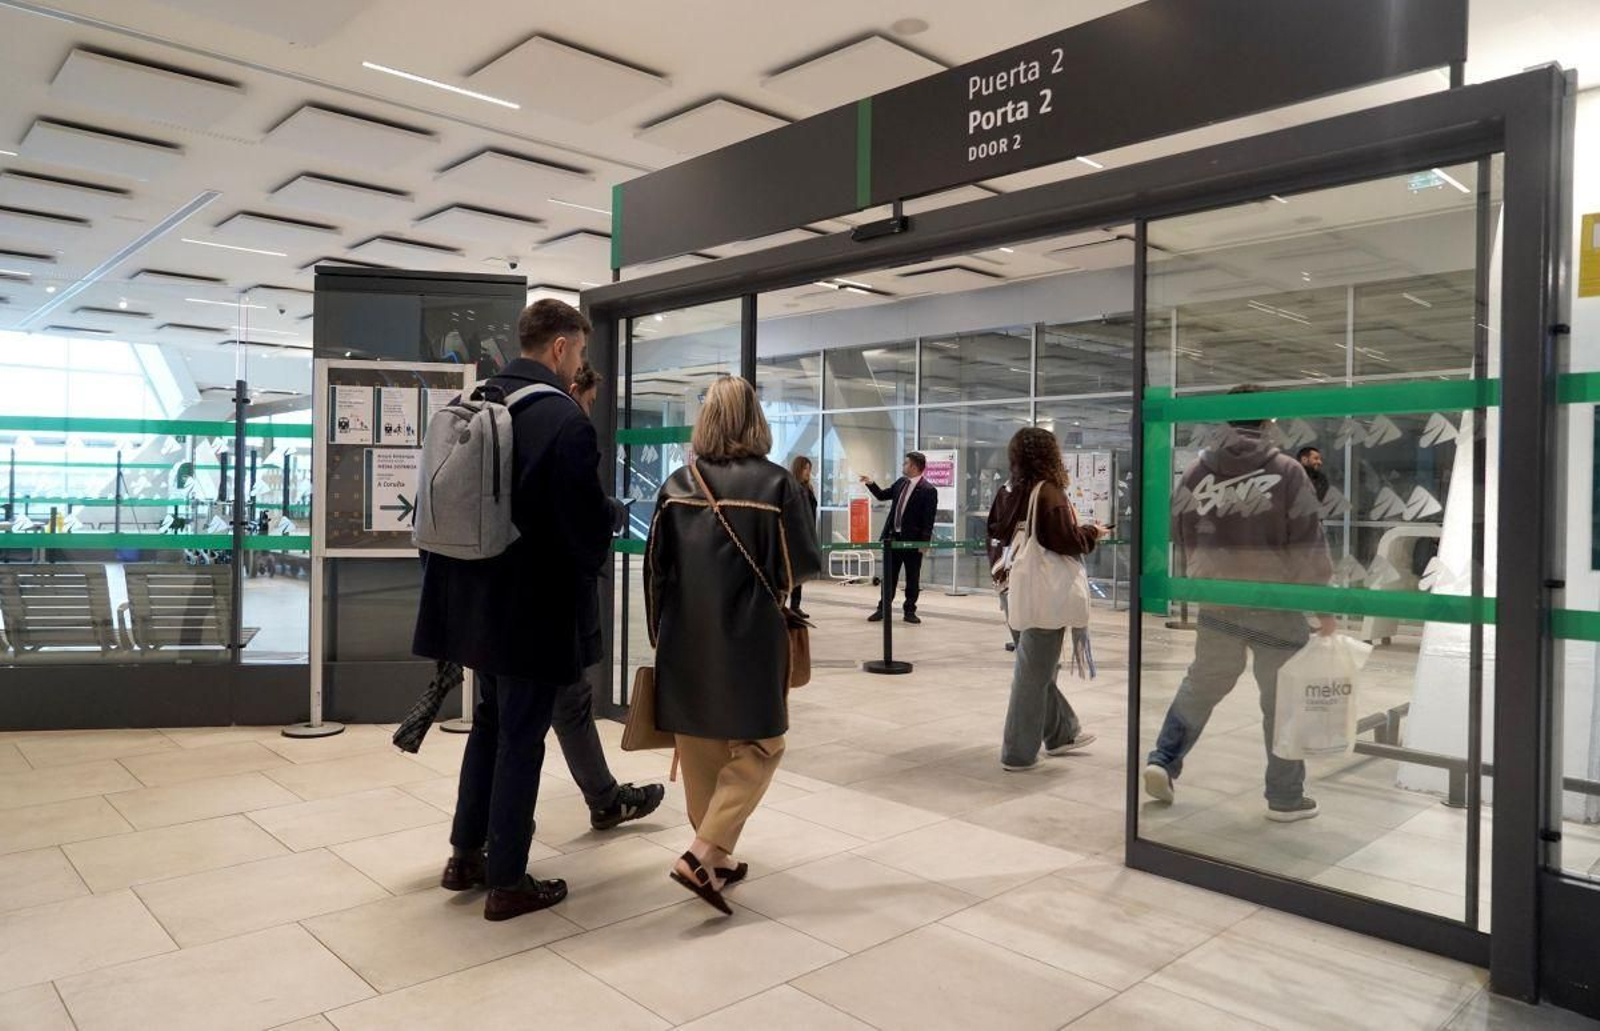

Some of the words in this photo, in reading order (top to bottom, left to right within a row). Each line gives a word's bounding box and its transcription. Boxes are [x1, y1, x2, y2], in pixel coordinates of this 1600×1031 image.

[969, 60, 1040, 100] Puerta
[1051, 48, 1064, 74] 2
[969, 100, 1029, 134] Porta
[1039, 88, 1053, 114] 2
[968, 138, 1008, 161] DOOR
[1012, 134, 1021, 150] 2
[1305, 681, 1352, 698] meka
